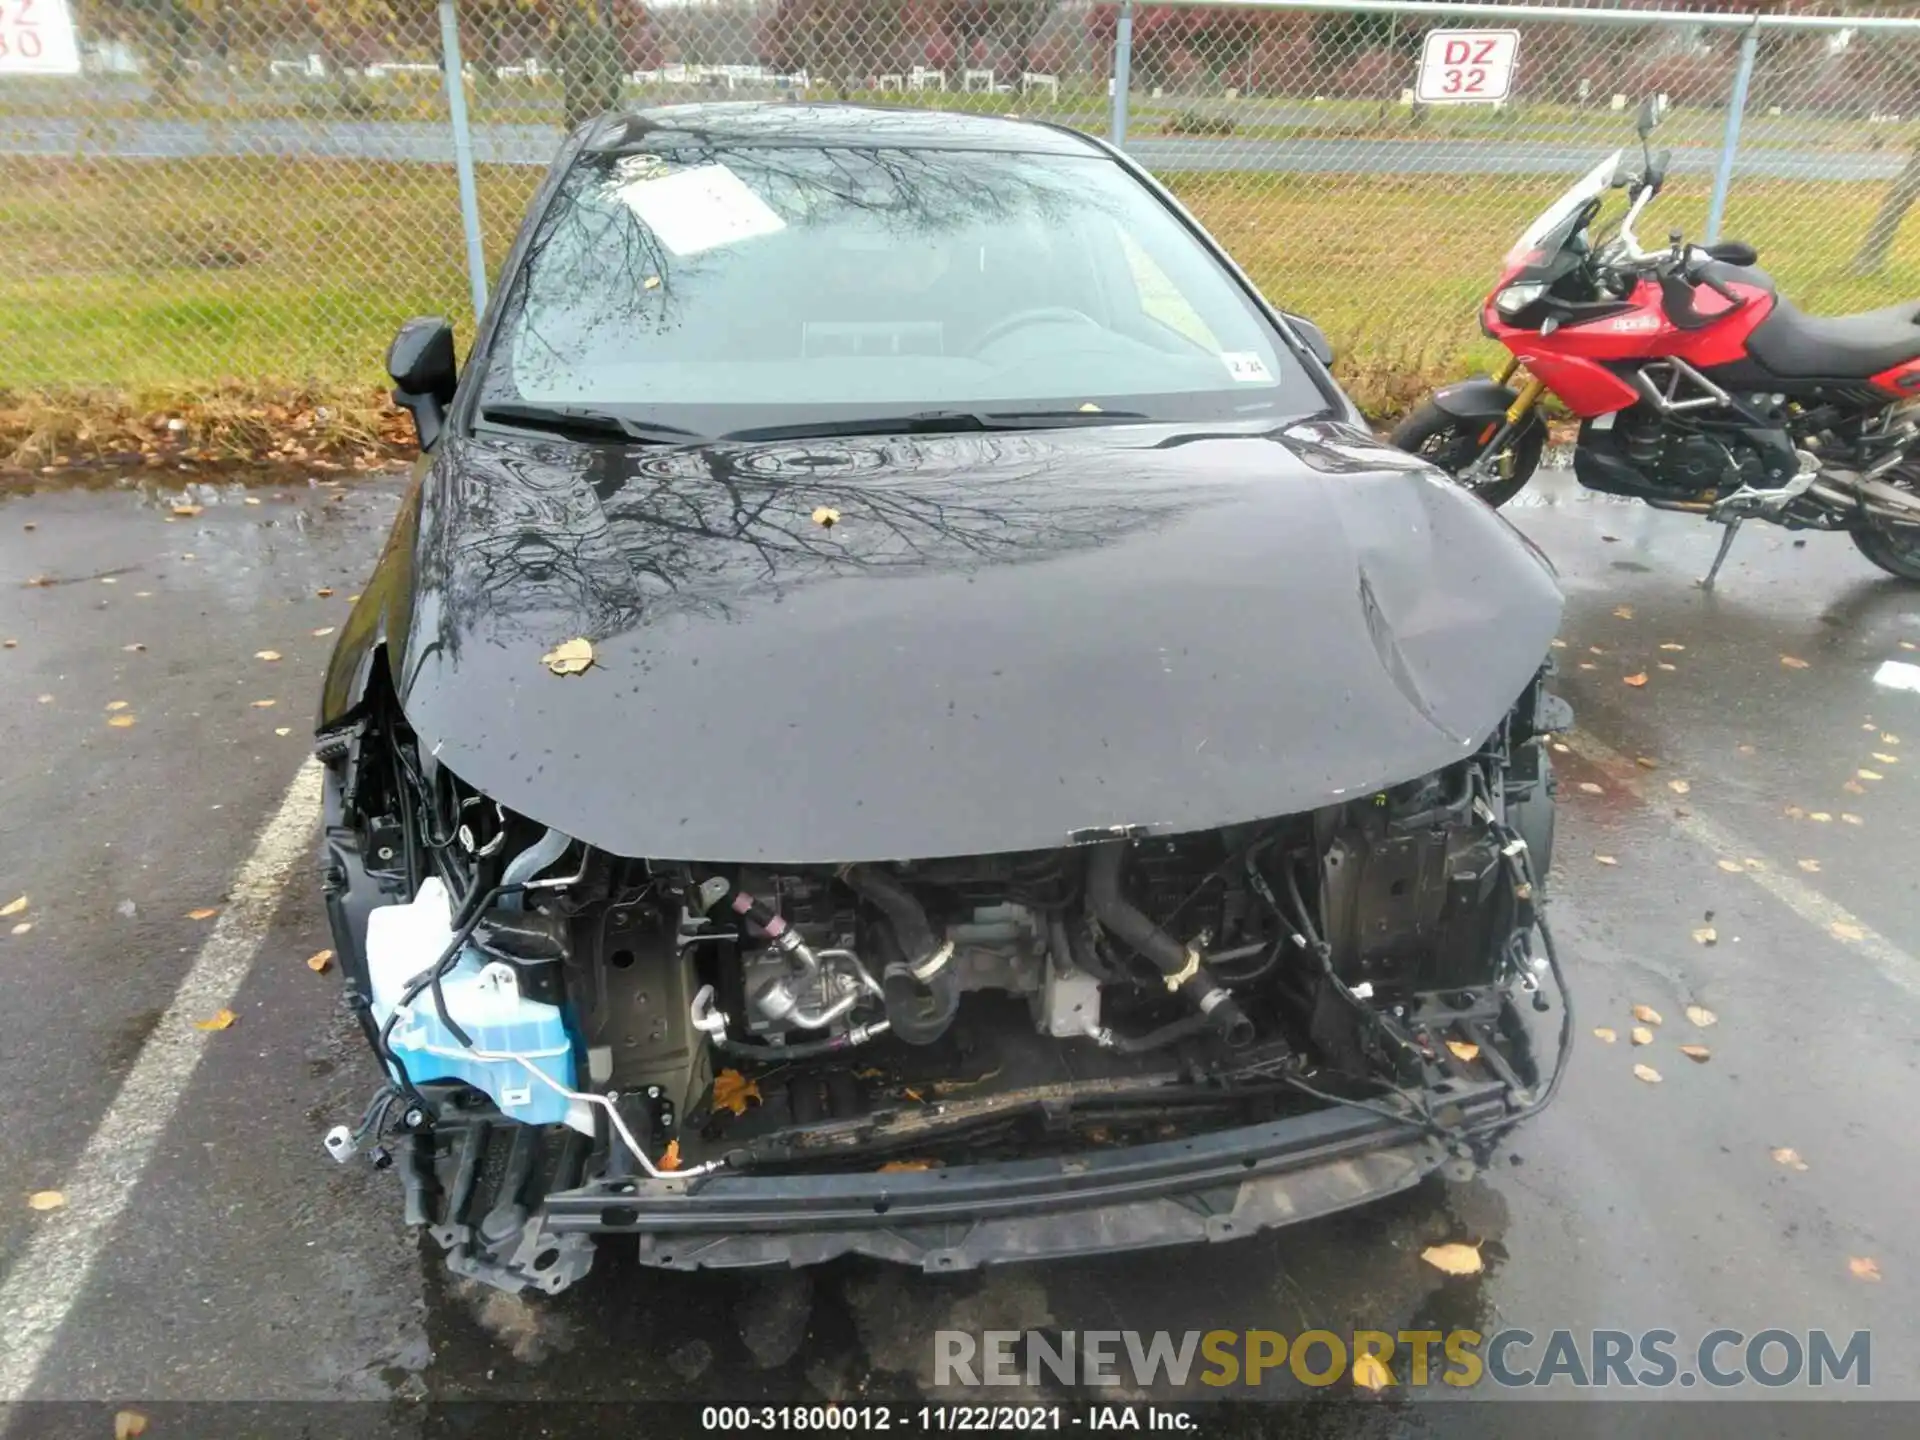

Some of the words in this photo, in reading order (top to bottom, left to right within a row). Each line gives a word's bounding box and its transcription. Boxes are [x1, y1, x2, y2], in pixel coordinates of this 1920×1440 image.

[0, 0, 40, 26] Z
[1444, 39, 1497, 65] DZ
[1442, 68, 1486, 93] 32
